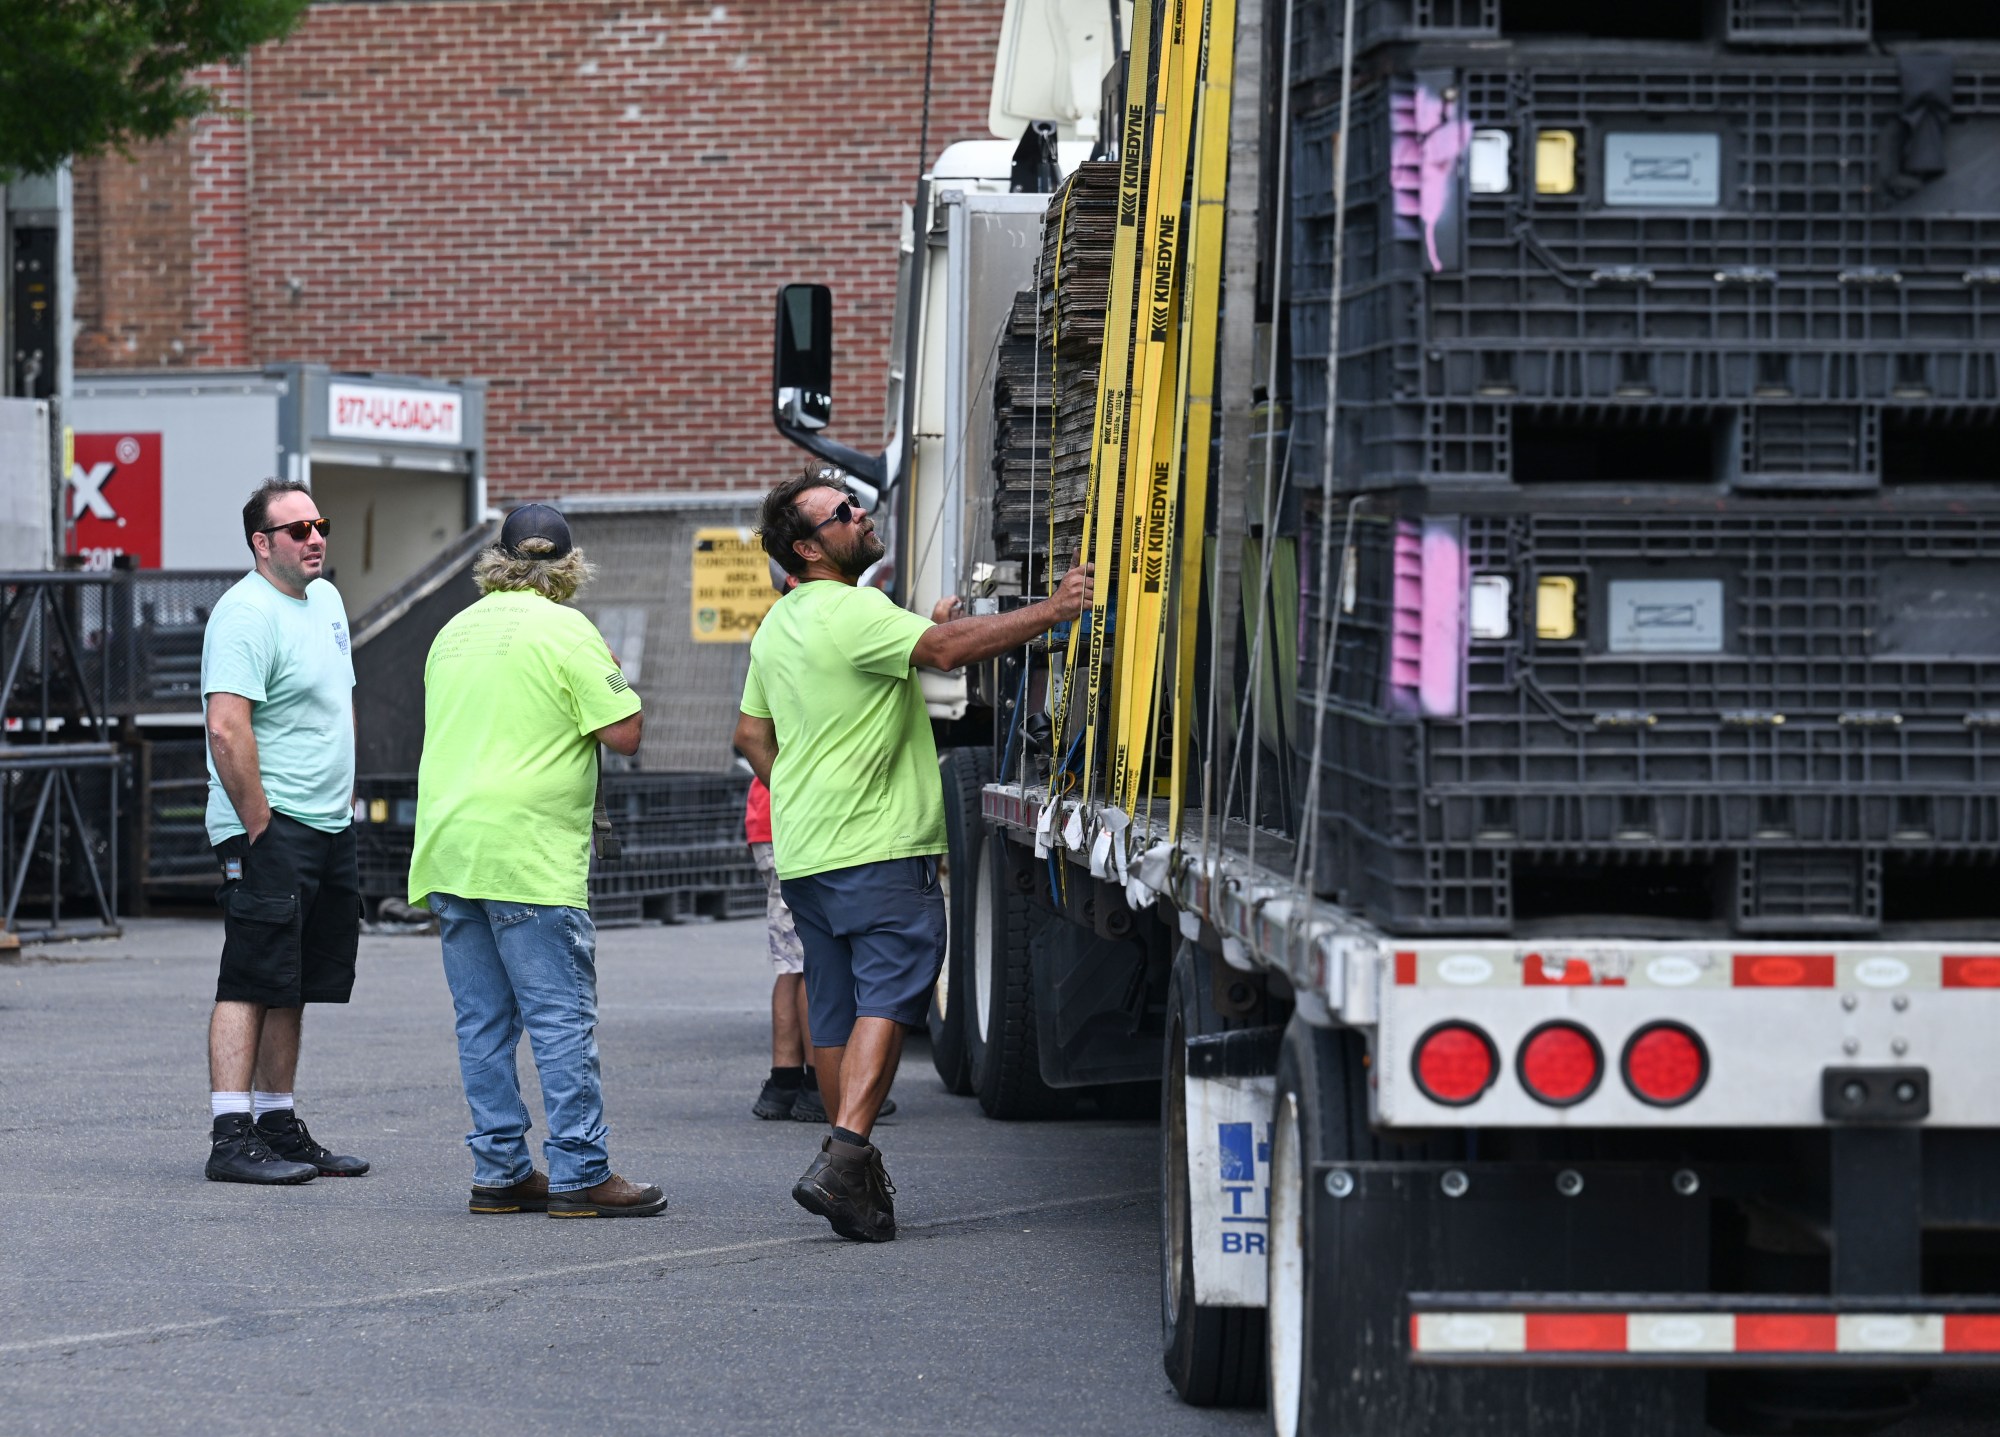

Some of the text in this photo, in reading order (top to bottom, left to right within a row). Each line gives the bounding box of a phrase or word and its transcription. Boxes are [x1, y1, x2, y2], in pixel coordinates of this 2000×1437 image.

[1124, 104, 1143, 188] KINEDYNE
[1154, 214, 1175, 302] KINEDYNE
[1106, 388, 1115, 425] KINEDYNE
[1133, 515, 1142, 553] KINEDYNE
[1148, 462, 1169, 552] KINEDYNE
[1163, 500, 1175, 591] KINEDYNE
[1090, 604, 1104, 688] KINEDYNE
[1056, 663, 1072, 740] KINEDYNE
